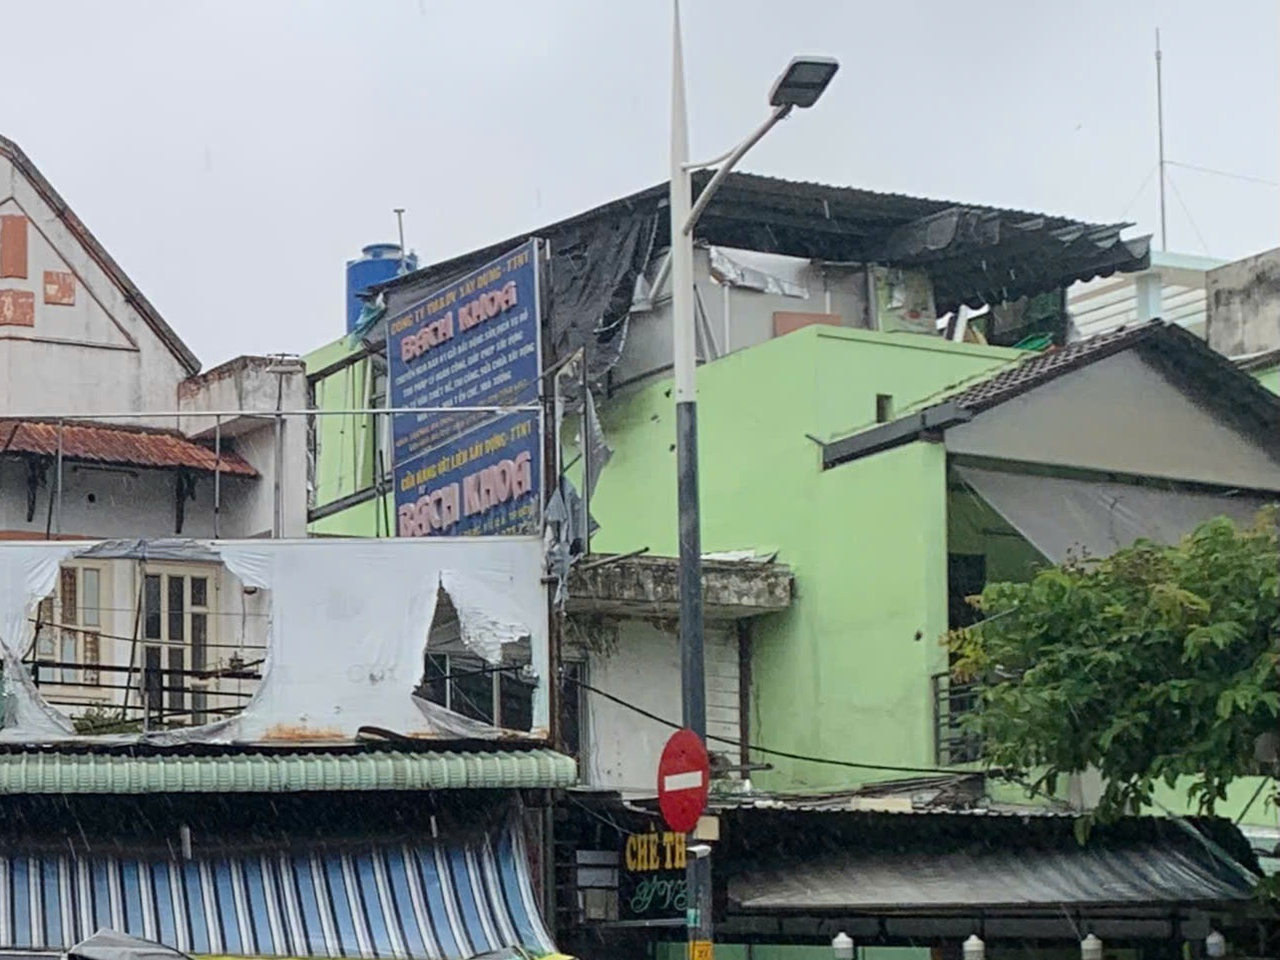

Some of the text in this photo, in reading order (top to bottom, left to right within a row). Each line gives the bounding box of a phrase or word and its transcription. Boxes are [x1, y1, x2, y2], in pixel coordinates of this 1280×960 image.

[457, 280, 517, 332] KHOA
[462, 450, 531, 516] KHOA
[626, 821, 687, 871] CHÈ TH
